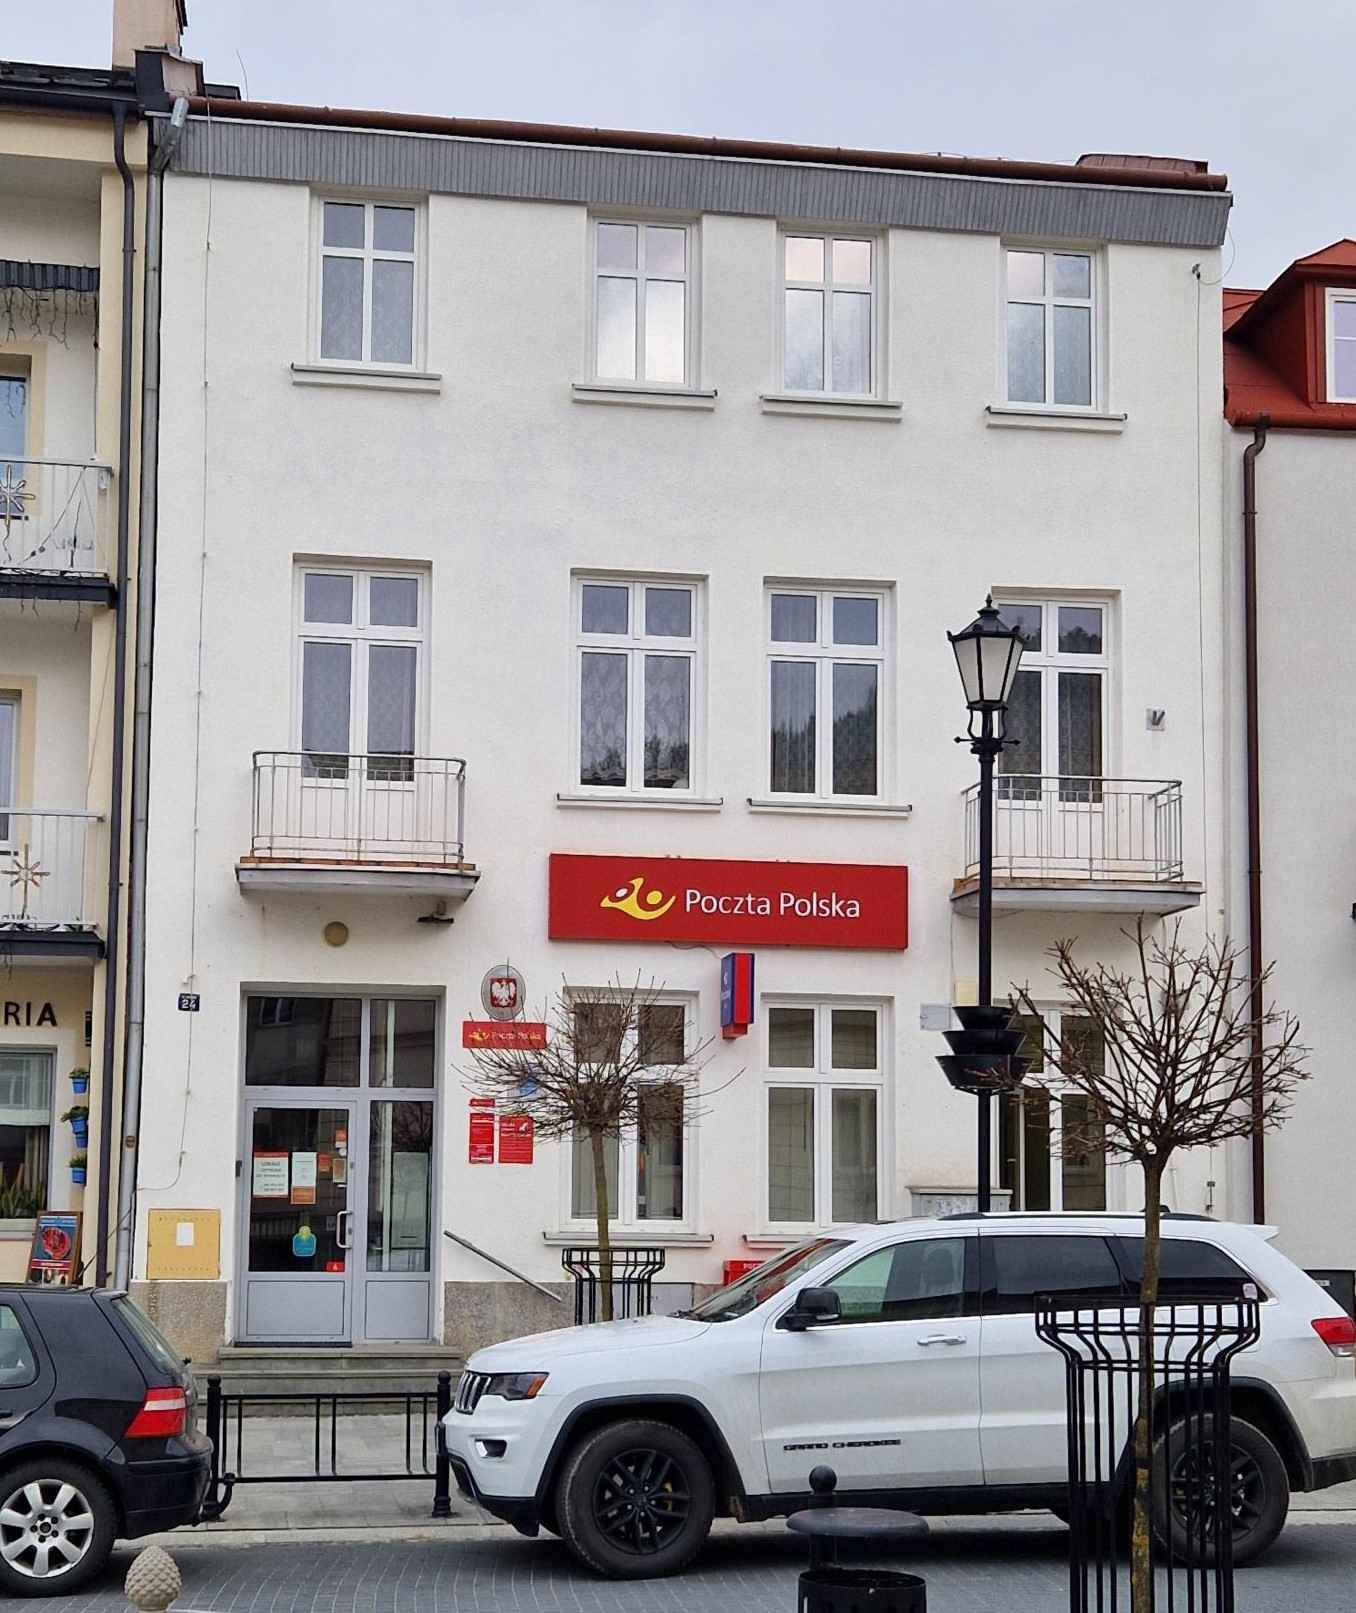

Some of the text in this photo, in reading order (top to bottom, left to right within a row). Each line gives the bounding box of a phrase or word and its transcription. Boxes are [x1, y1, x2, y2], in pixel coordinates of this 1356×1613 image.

[685, 889, 861, 918] Poczta Polska
[4, 1001, 58, 1026] RIA
[182, 999, 197, 1009] 24
